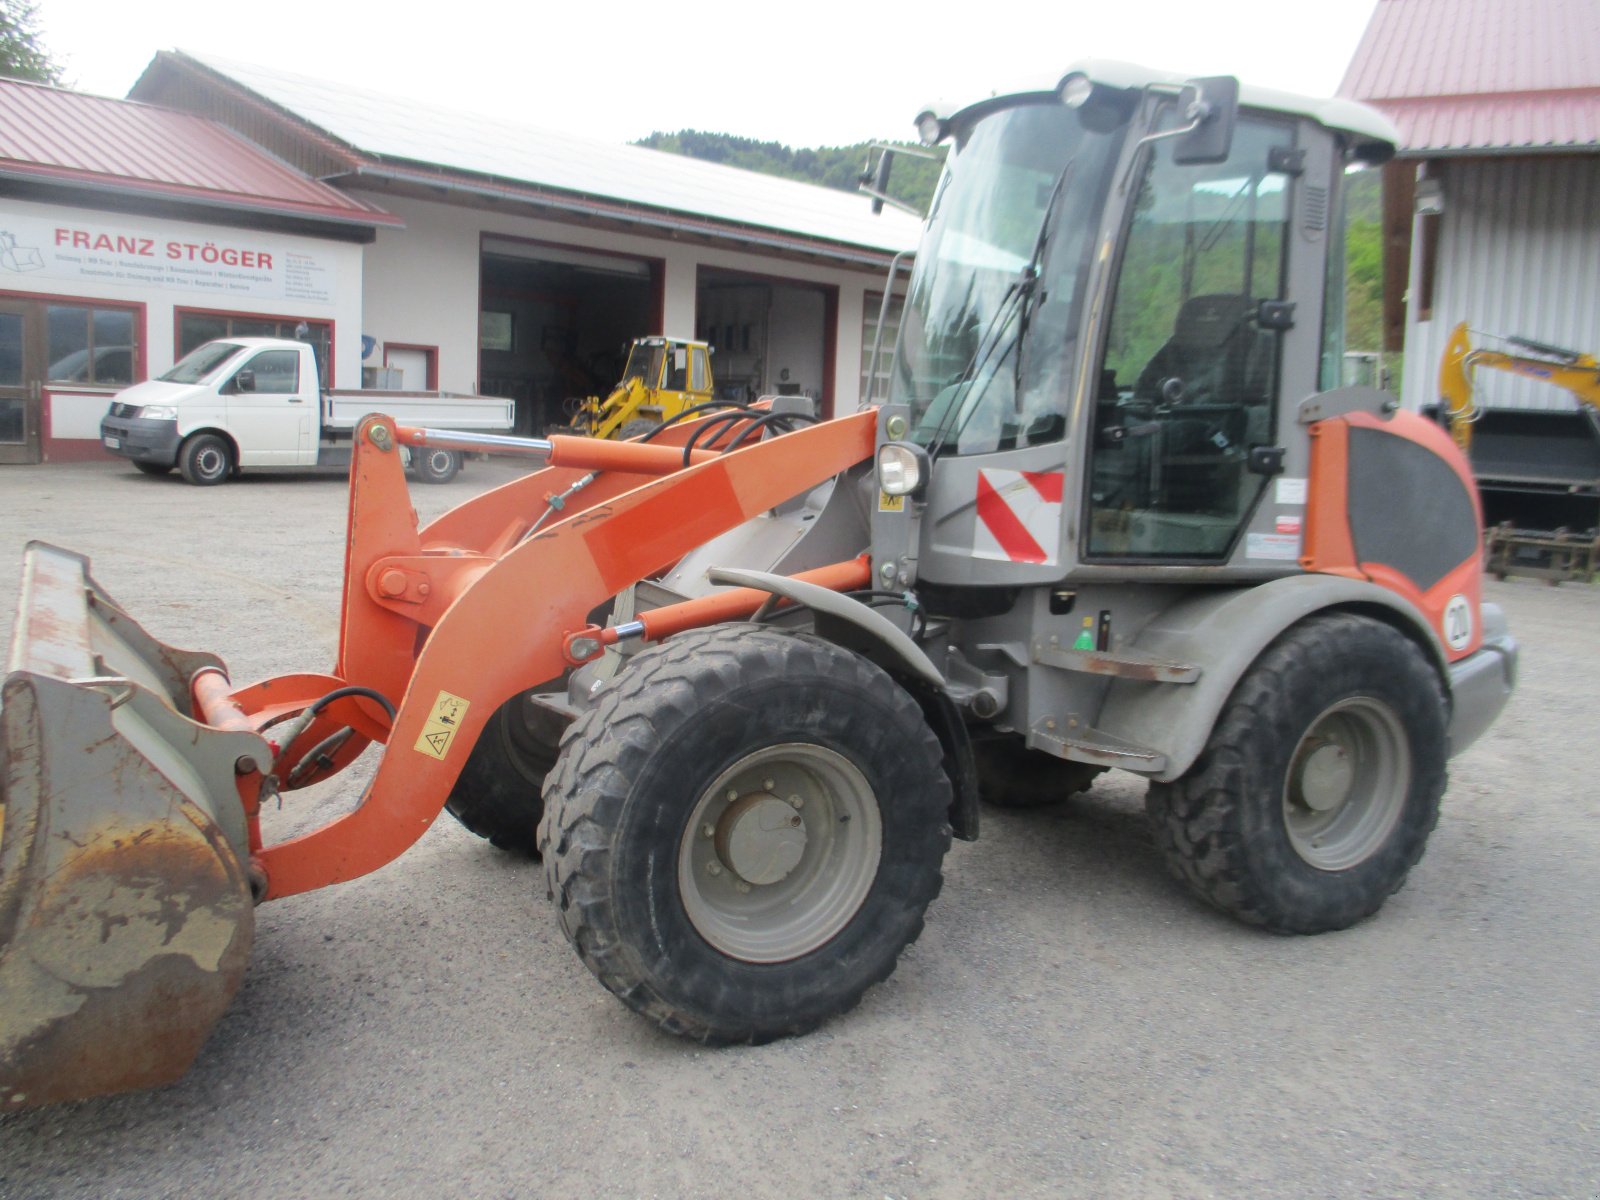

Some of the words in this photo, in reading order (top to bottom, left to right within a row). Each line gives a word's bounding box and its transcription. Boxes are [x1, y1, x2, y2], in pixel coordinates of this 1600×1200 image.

[55, 228, 155, 257] FRANZ
[166, 241, 273, 270] STÖGER
[1448, 604, 1469, 641] 20
